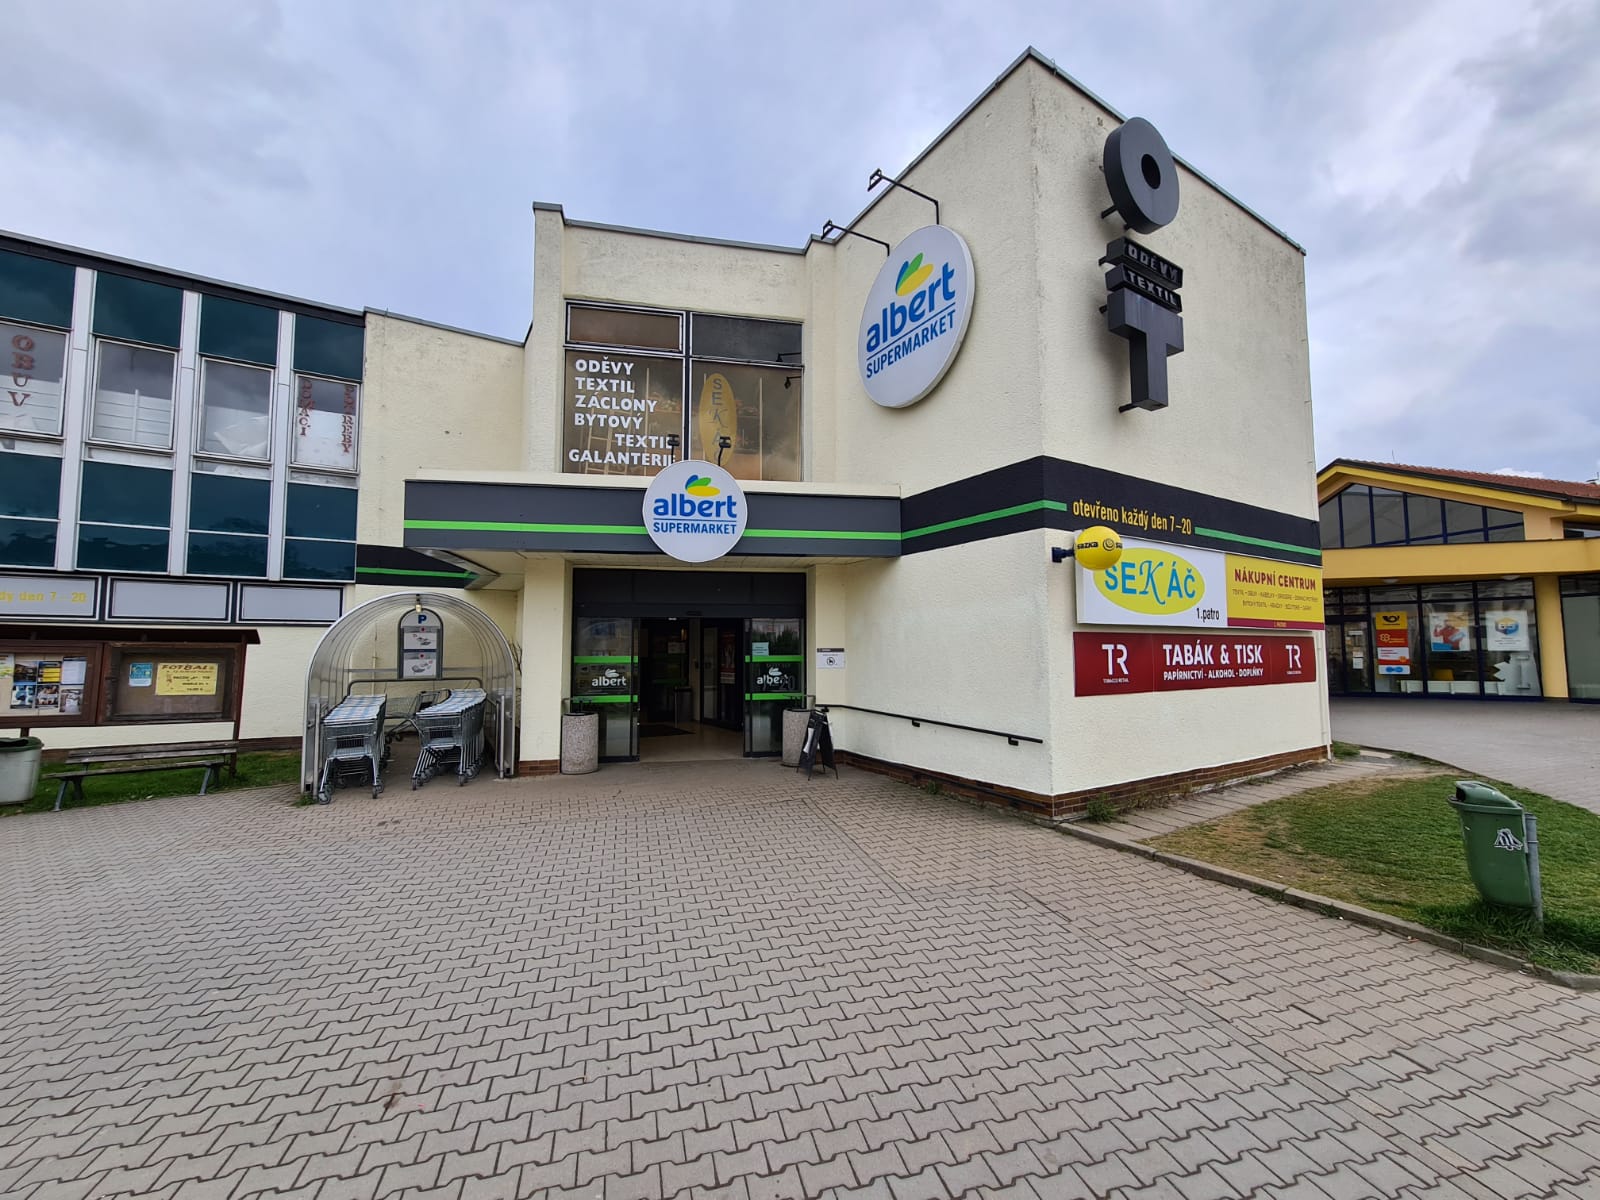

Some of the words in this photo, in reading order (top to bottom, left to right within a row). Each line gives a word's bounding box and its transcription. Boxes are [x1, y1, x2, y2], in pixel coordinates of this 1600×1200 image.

[1127, 270, 1178, 306] TEXTIL
[866, 262, 956, 353] albert
[866, 309, 956, 379] SUPERMARKET
[575, 356, 634, 376] ODĚVY
[575, 376, 635, 394] TEXTIL
[575, 391, 658, 413] ZÁCLONY
[574, 412, 644, 430] BYTOVÝ
[653, 493, 737, 518] albert
[1073, 499, 1119, 523] otevřeno
[1121, 506, 1149, 531] každý
[1151, 512, 1168, 530] den
[653, 521, 737, 535] SUPERMARKET
[1104, 560, 1196, 605] SEKÁČ
[1234, 566, 1276, 587] NÁKUPNÍ
[1278, 574, 1316, 591] CENTRUM
[418, 615, 427, 624] P
[1162, 639, 1214, 666] TABÁK
[1220, 644, 1230, 665] &
[1234, 644, 1263, 664] TISK
[591, 676, 627, 687] albert
[1163, 669, 1204, 681] PAPÍRNICTVÍ
[1208, 668, 1235, 679] ALKOHOL
[1239, 666, 1264, 677] DOPLŇKY
